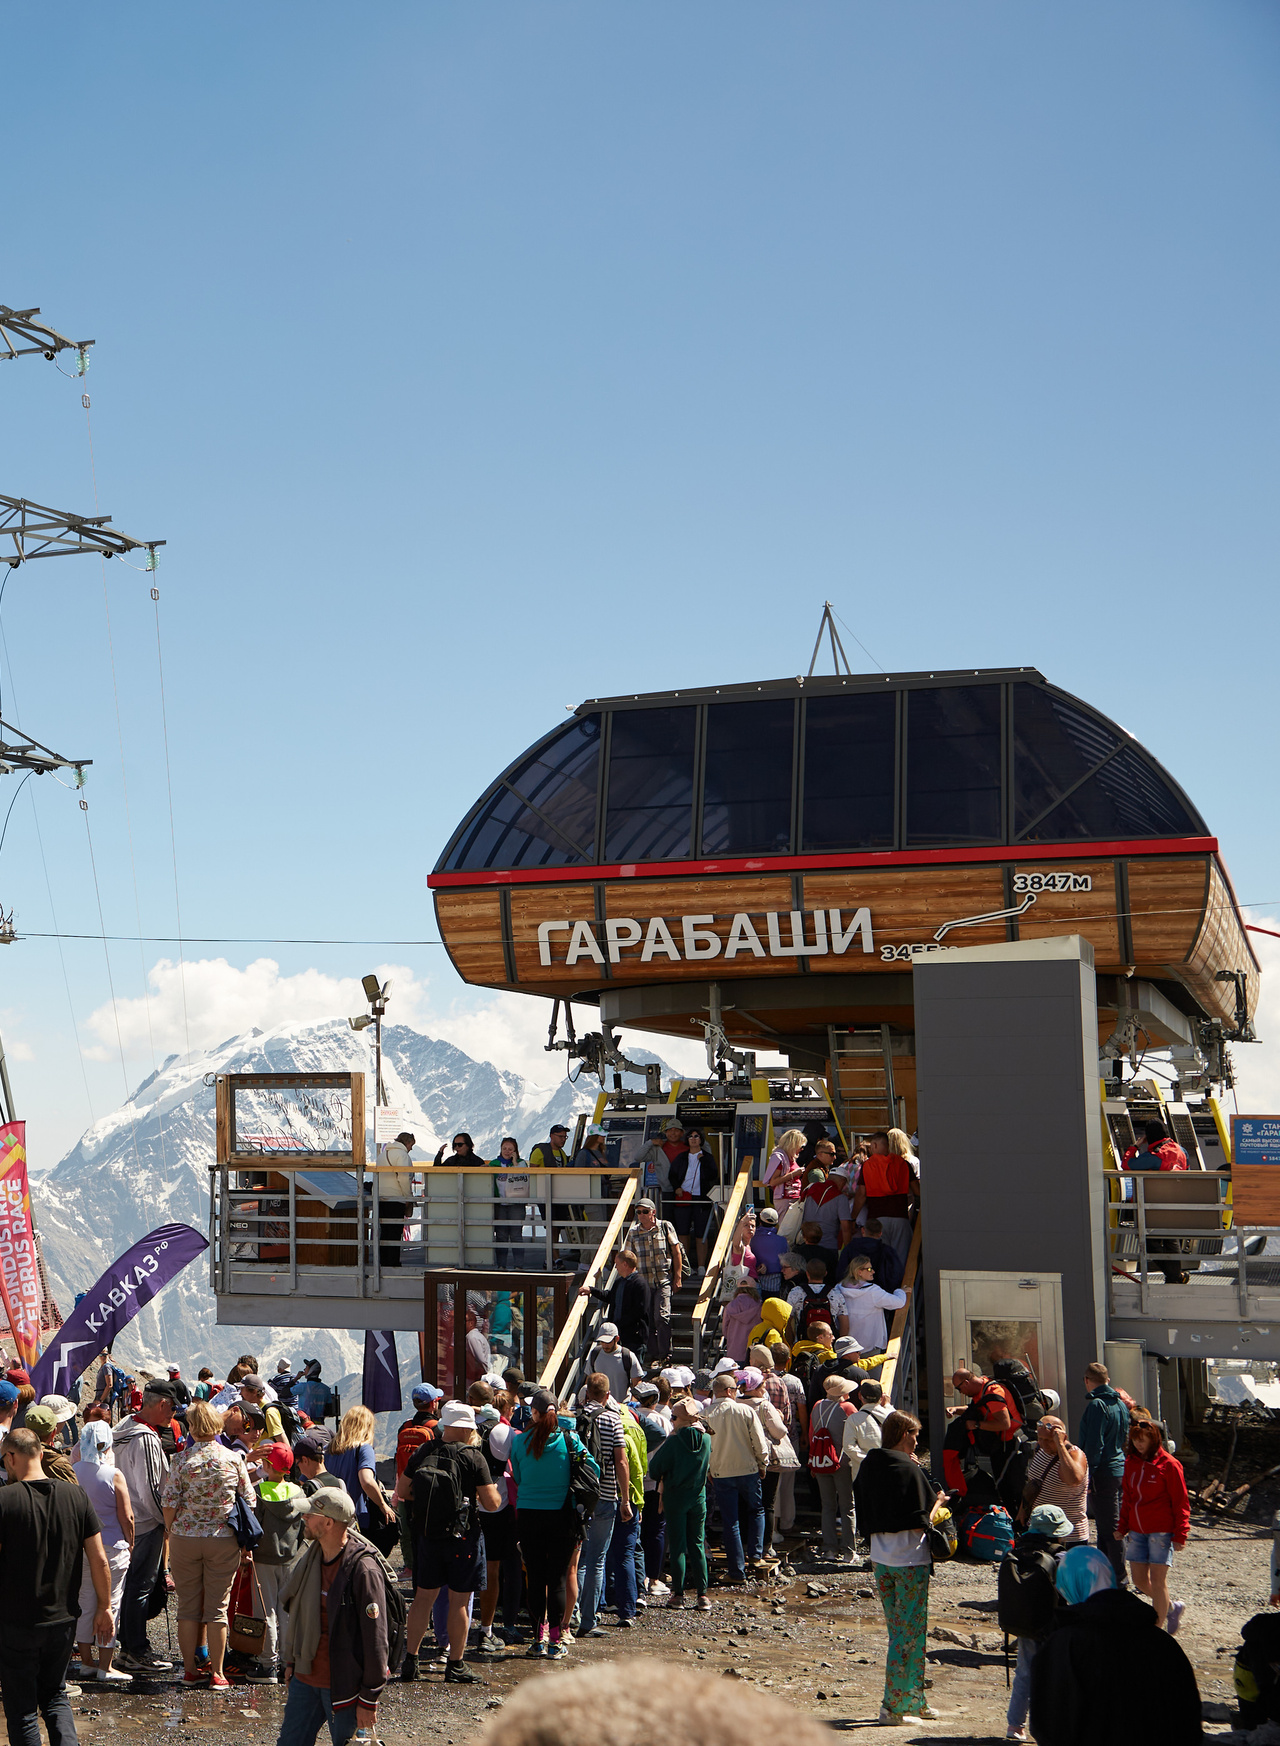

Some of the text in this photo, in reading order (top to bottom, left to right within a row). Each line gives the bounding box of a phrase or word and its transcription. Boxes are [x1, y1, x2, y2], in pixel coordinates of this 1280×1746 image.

[537, 907, 875, 966] ГАРАБАШИ
[6, 1178, 39, 1322] ELBRUS RACE
[85, 1240, 169, 1333] КАВКАЗ РФ
